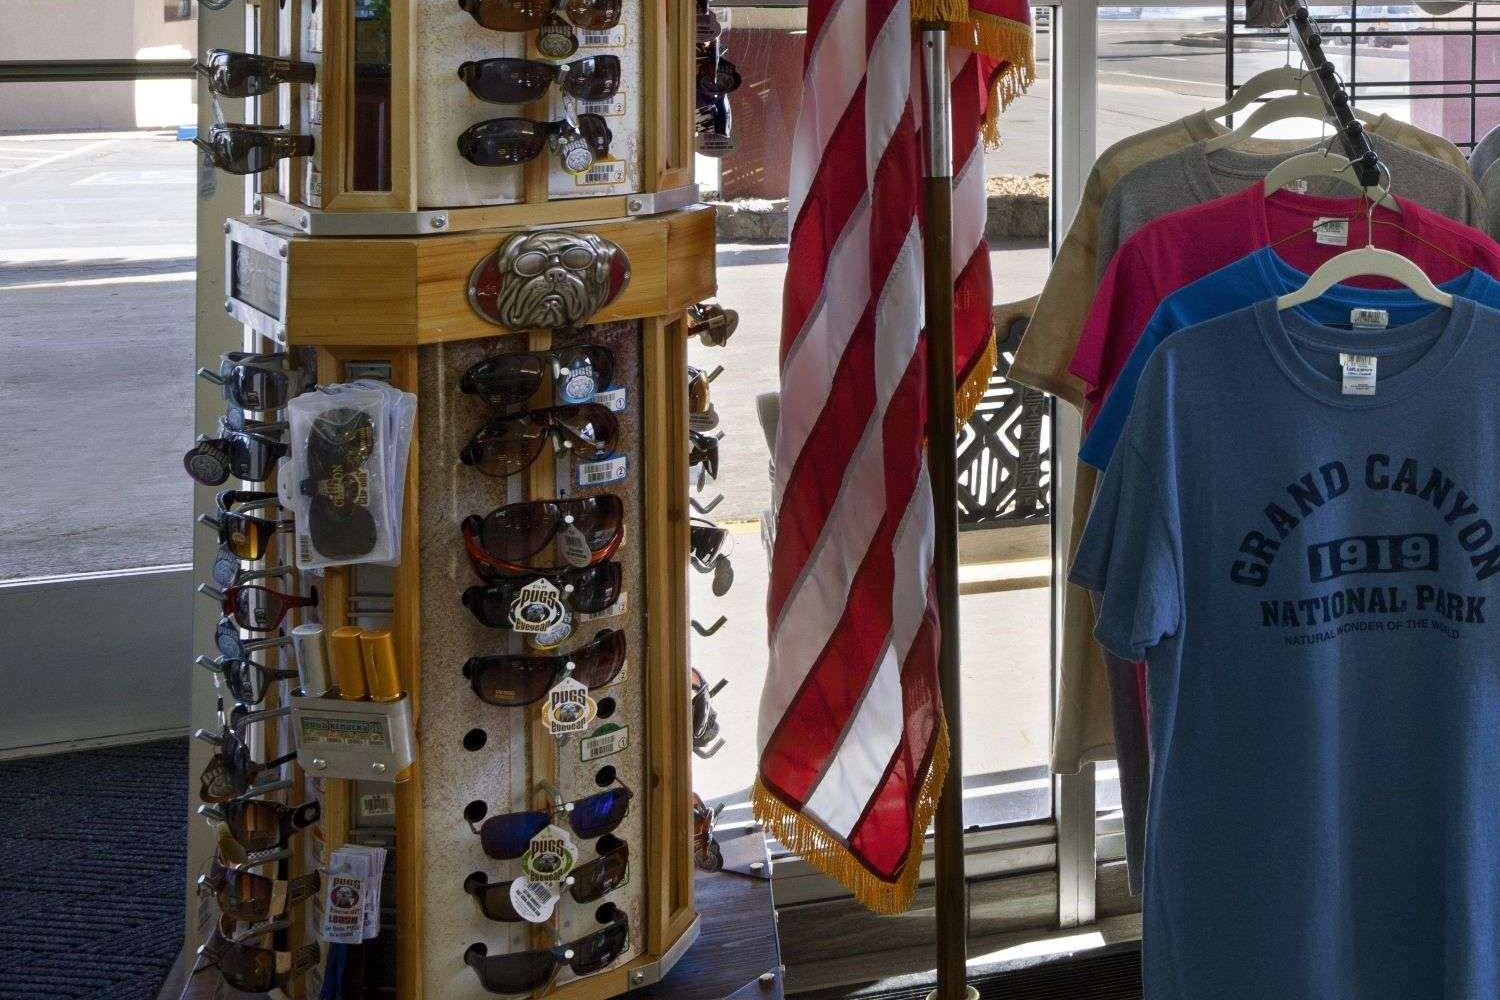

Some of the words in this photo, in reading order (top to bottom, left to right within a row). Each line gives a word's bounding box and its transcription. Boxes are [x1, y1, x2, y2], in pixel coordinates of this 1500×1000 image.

[1230, 460, 1351, 588] GRAND
[1319, 535, 1432, 578] 1919
[521, 589, 559, 609] PUGS
[1259, 586, 1408, 628] NATIONAL
[1415, 584, 1487, 624] PARK
[1285, 631, 1336, 647] NATURAL
[1336, 621, 1384, 636] WONDER
[1387, 621, 1404, 631] OF
[1406, 619, 1429, 630] THE
[551, 688, 587, 711] PUGS
[532, 840, 565, 860] PUGS
